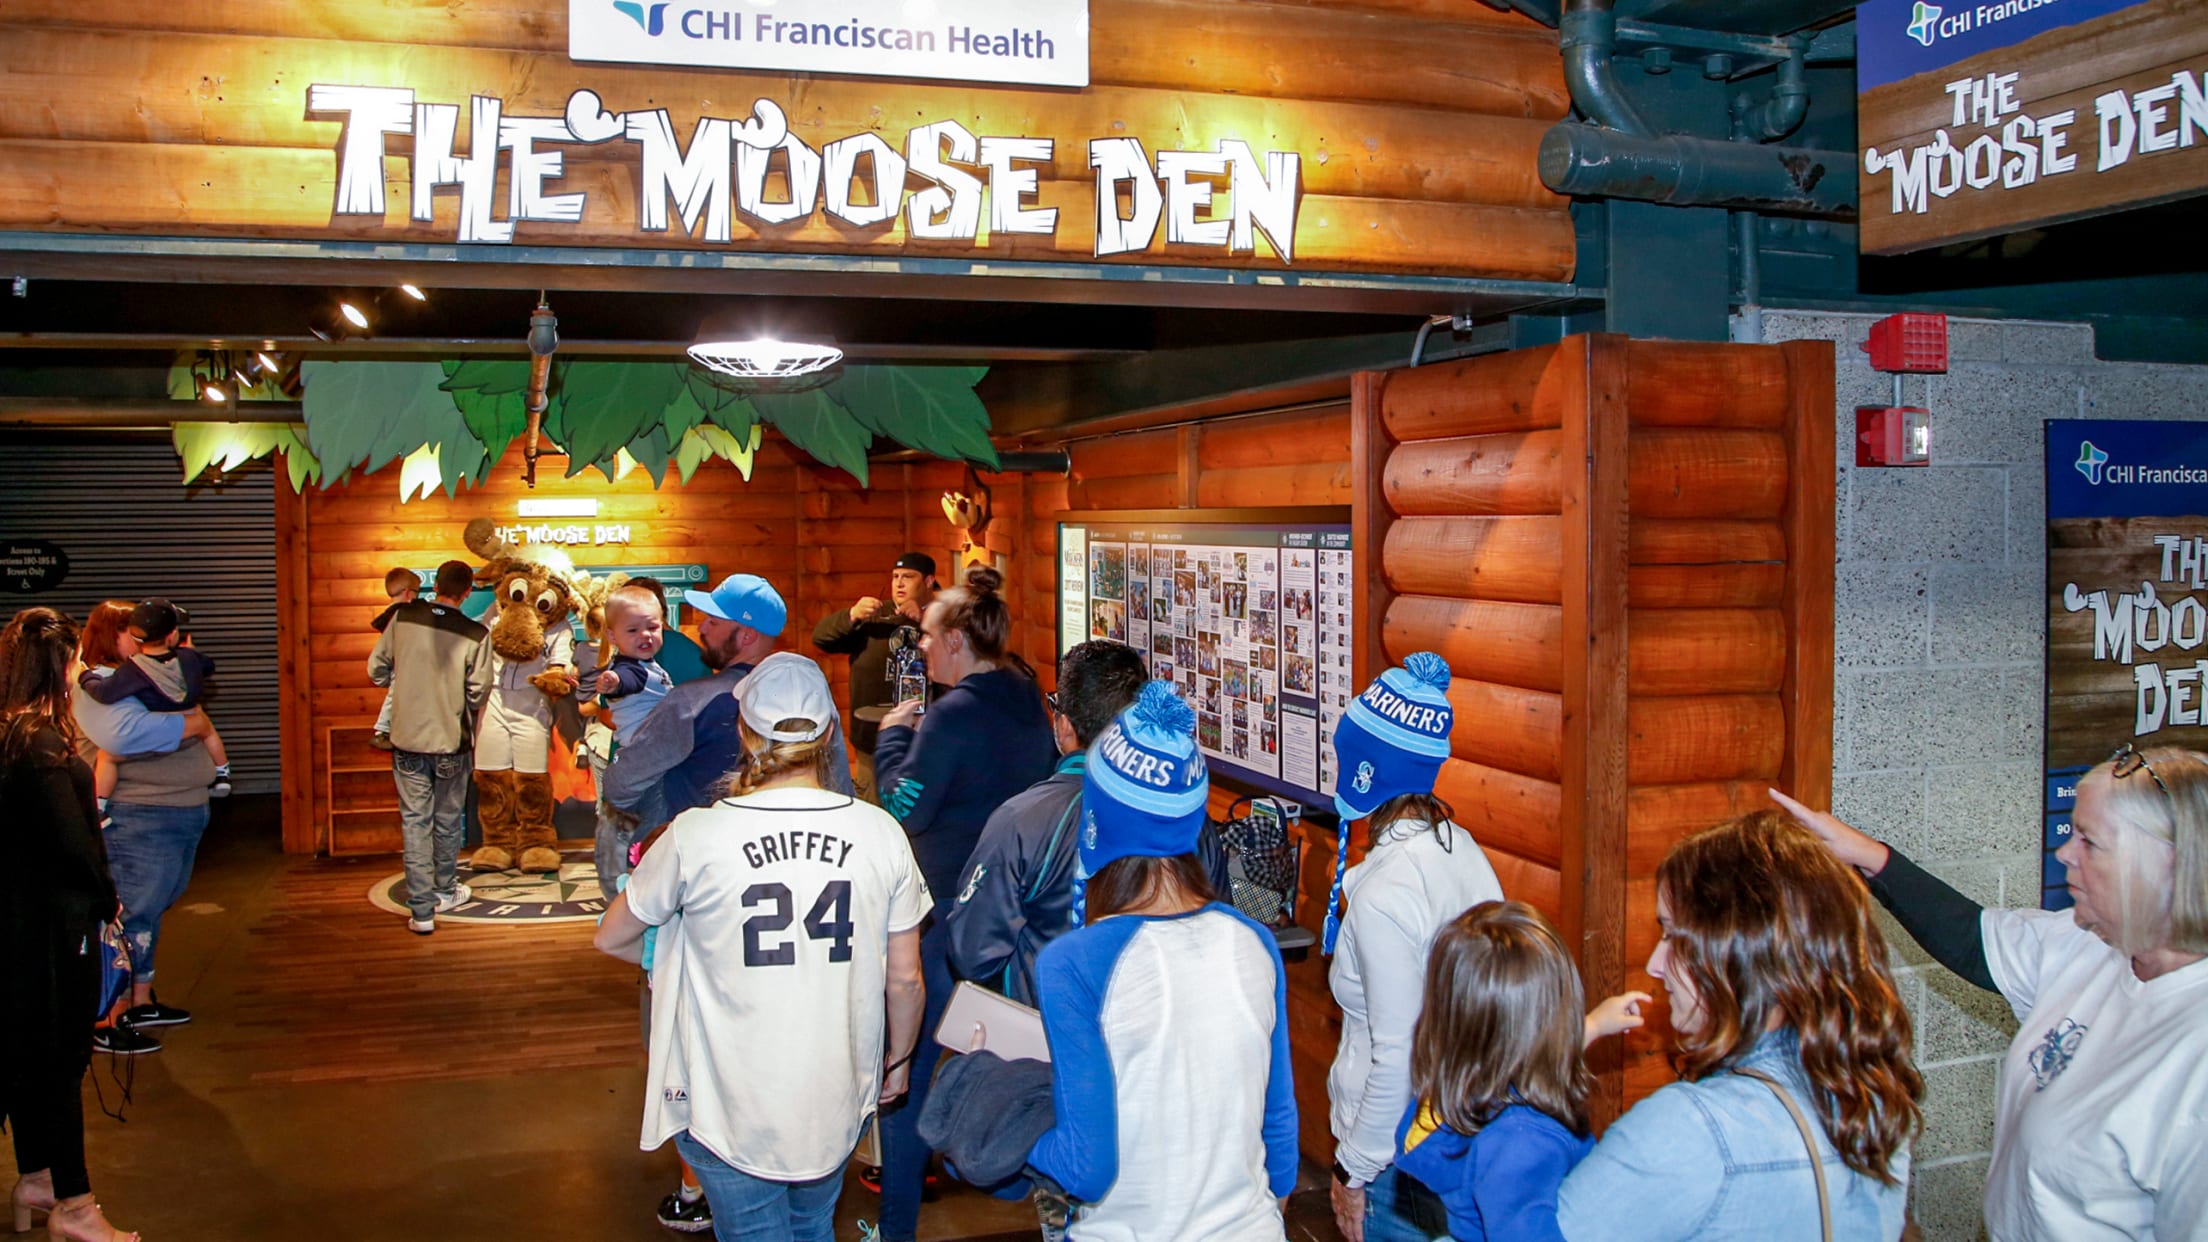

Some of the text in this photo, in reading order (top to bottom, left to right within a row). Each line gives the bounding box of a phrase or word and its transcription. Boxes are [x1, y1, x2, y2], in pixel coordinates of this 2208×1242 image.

[681, 9, 1054, 60] CHI Franciscan Health
[1940, 11, 1971, 38] CHI
[1945, 72, 2021, 128] THE
[308, 83, 1299, 265] THE MOOSE DEN
[1865, 110, 2078, 215] MOOSE
[2106, 464, 2208, 484] CHI Francisca
[495, 524, 630, 546] HE MOOSE DEN
[2064, 581, 2208, 664] MOO
[1103, 724, 1175, 787] RINERS
[742, 831, 853, 869] GRIFFEY
[741, 880, 854, 967] 24
